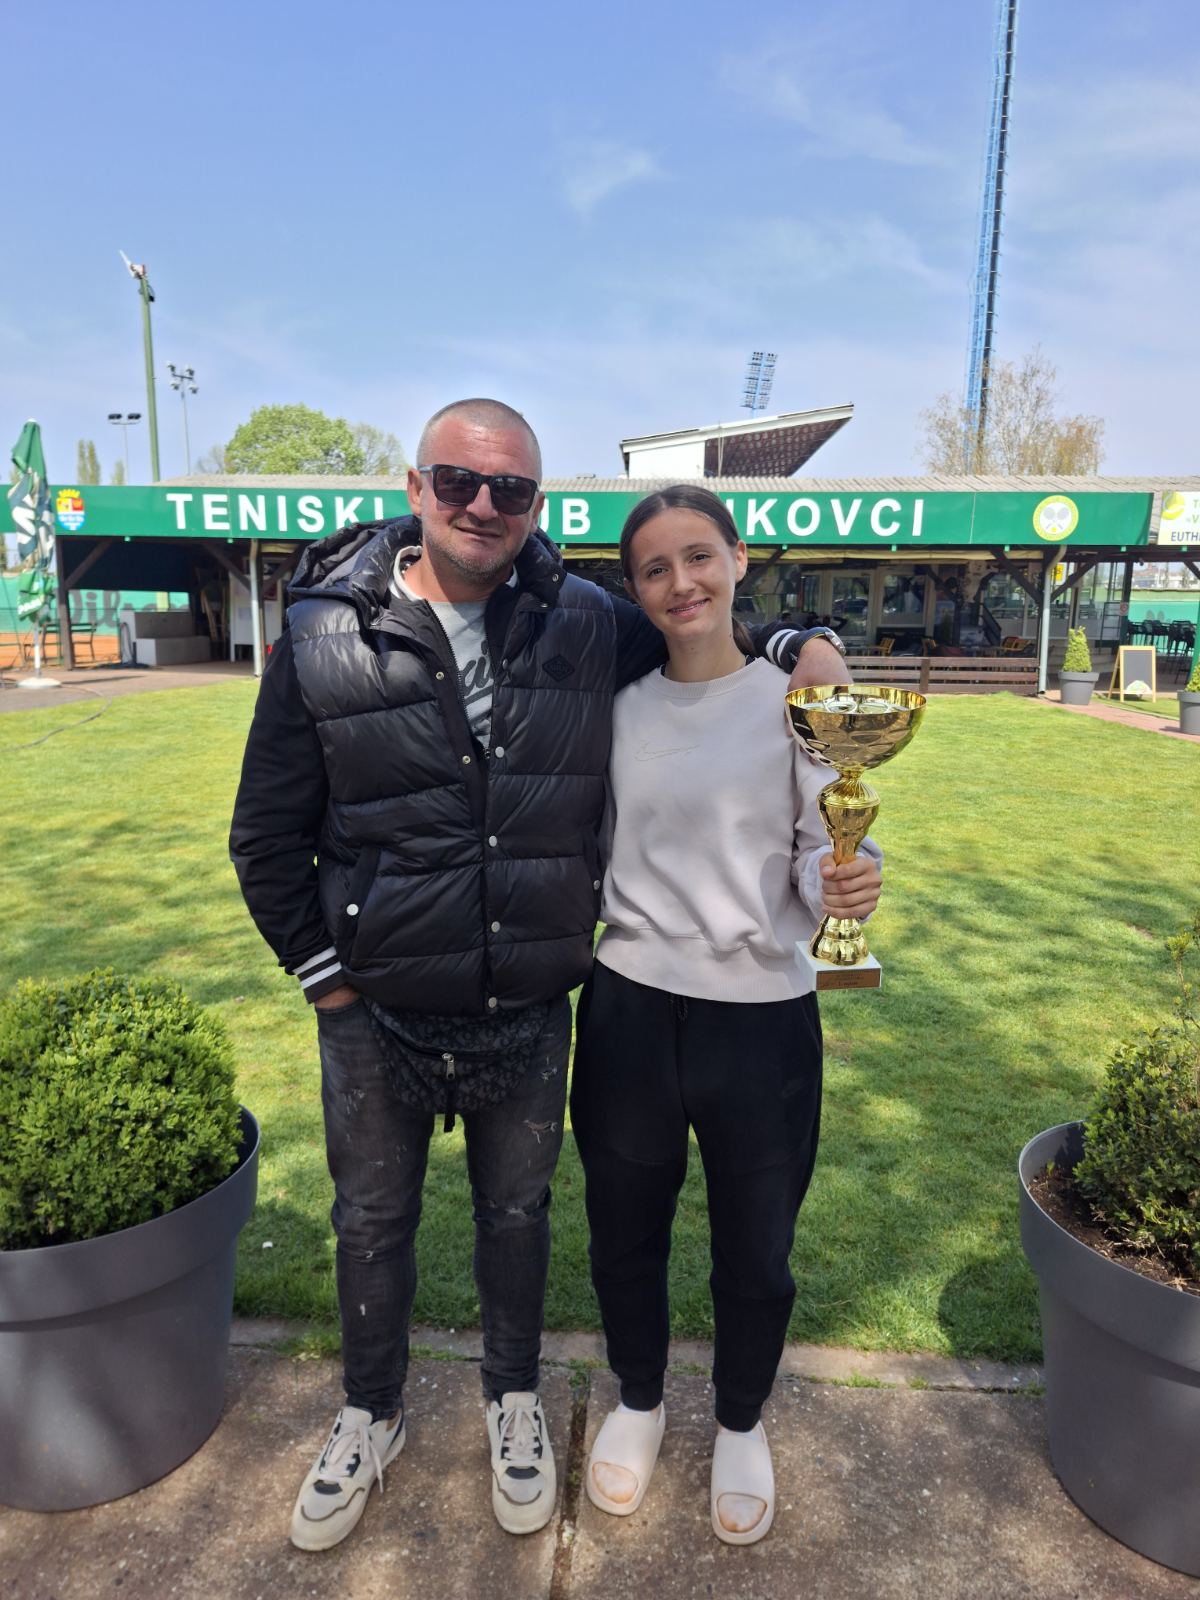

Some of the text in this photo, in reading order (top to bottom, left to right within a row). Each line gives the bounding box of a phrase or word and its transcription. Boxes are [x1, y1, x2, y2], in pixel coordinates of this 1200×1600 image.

[166, 493, 384, 533] TENISKI
[725, 497, 924, 537] KOVCI
[1171, 531, 1200, 542] EUTH
